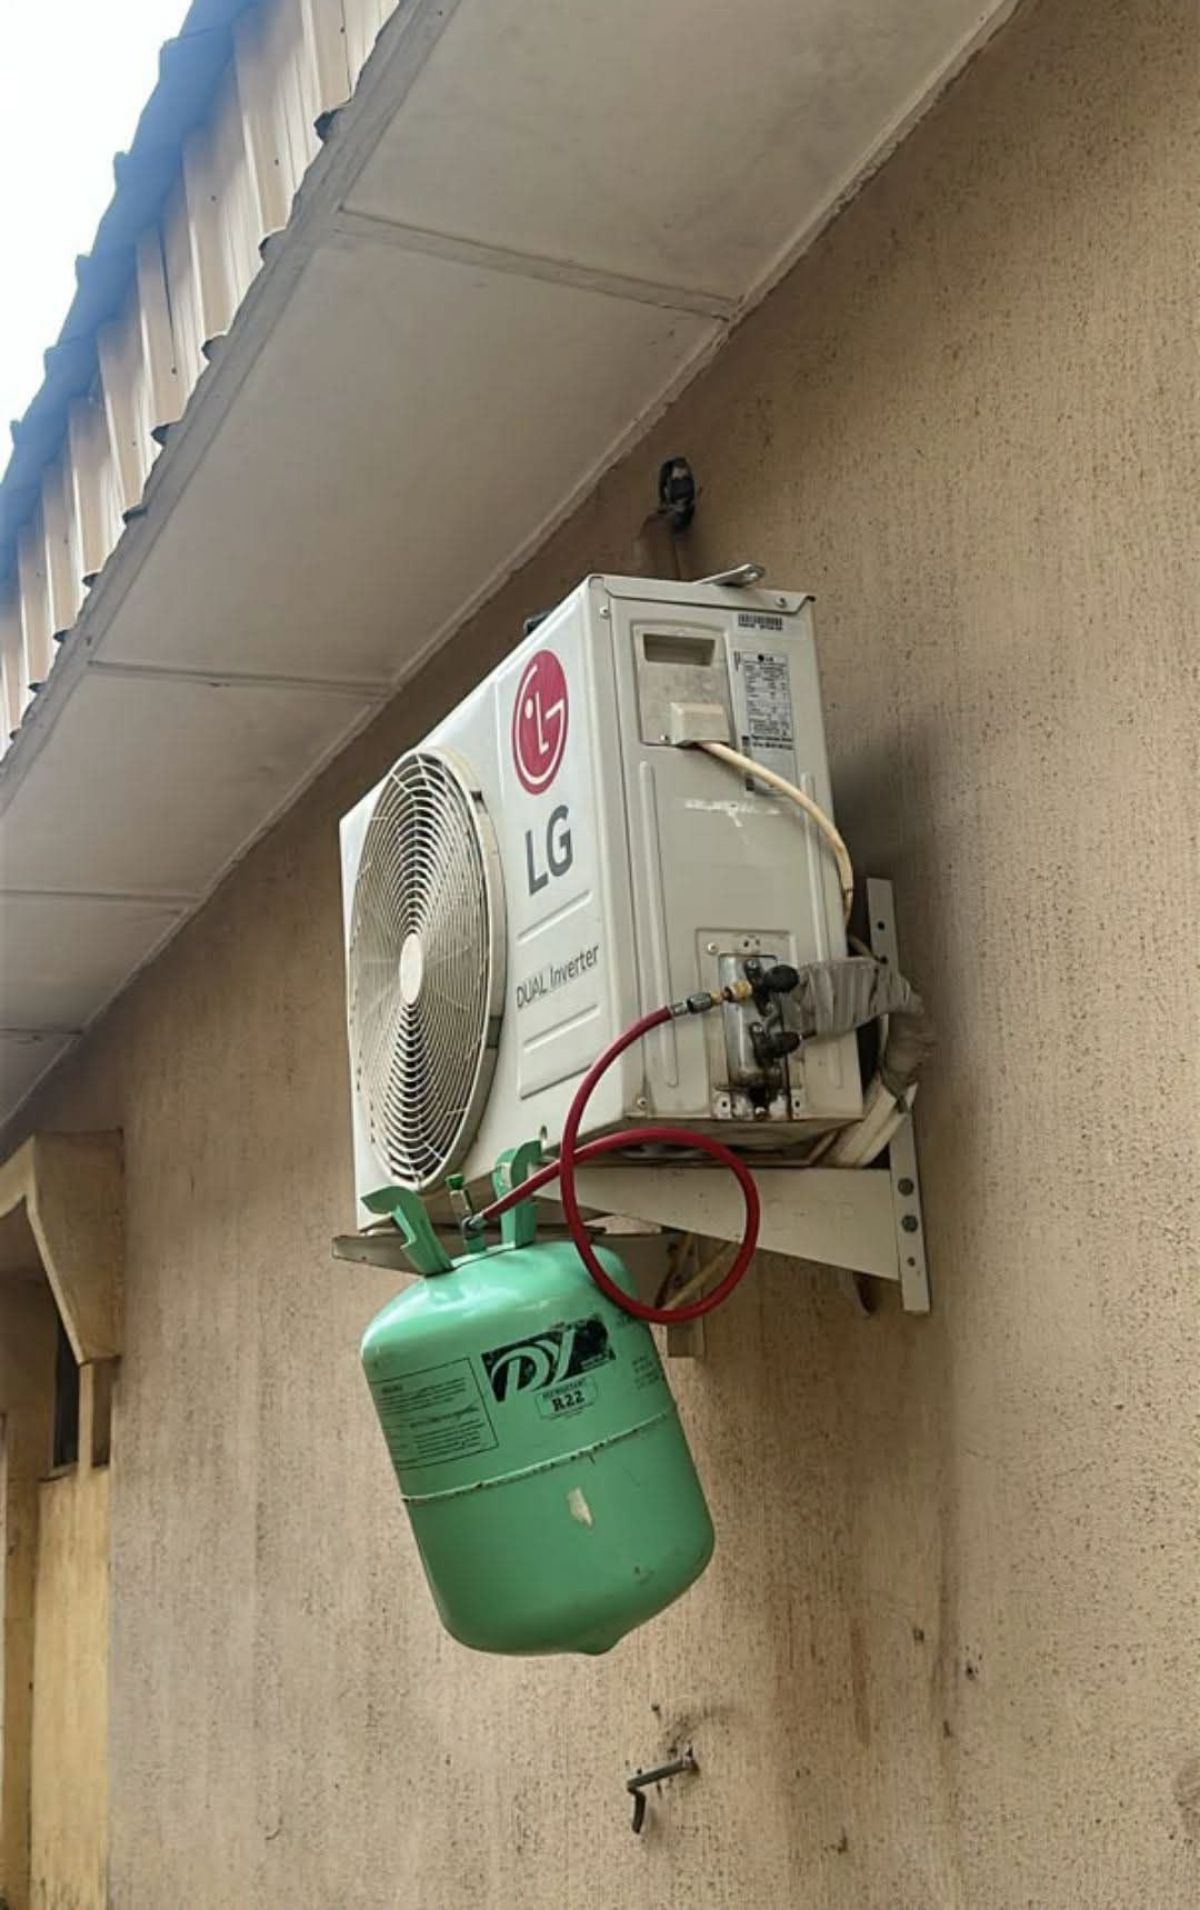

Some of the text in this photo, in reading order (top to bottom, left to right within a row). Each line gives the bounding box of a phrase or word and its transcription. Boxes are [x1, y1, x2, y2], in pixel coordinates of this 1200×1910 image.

[525, 804, 573, 896] LG
[516, 944, 599, 1009] DUAL Inverter
[552, 1390, 585, 1412] R22
